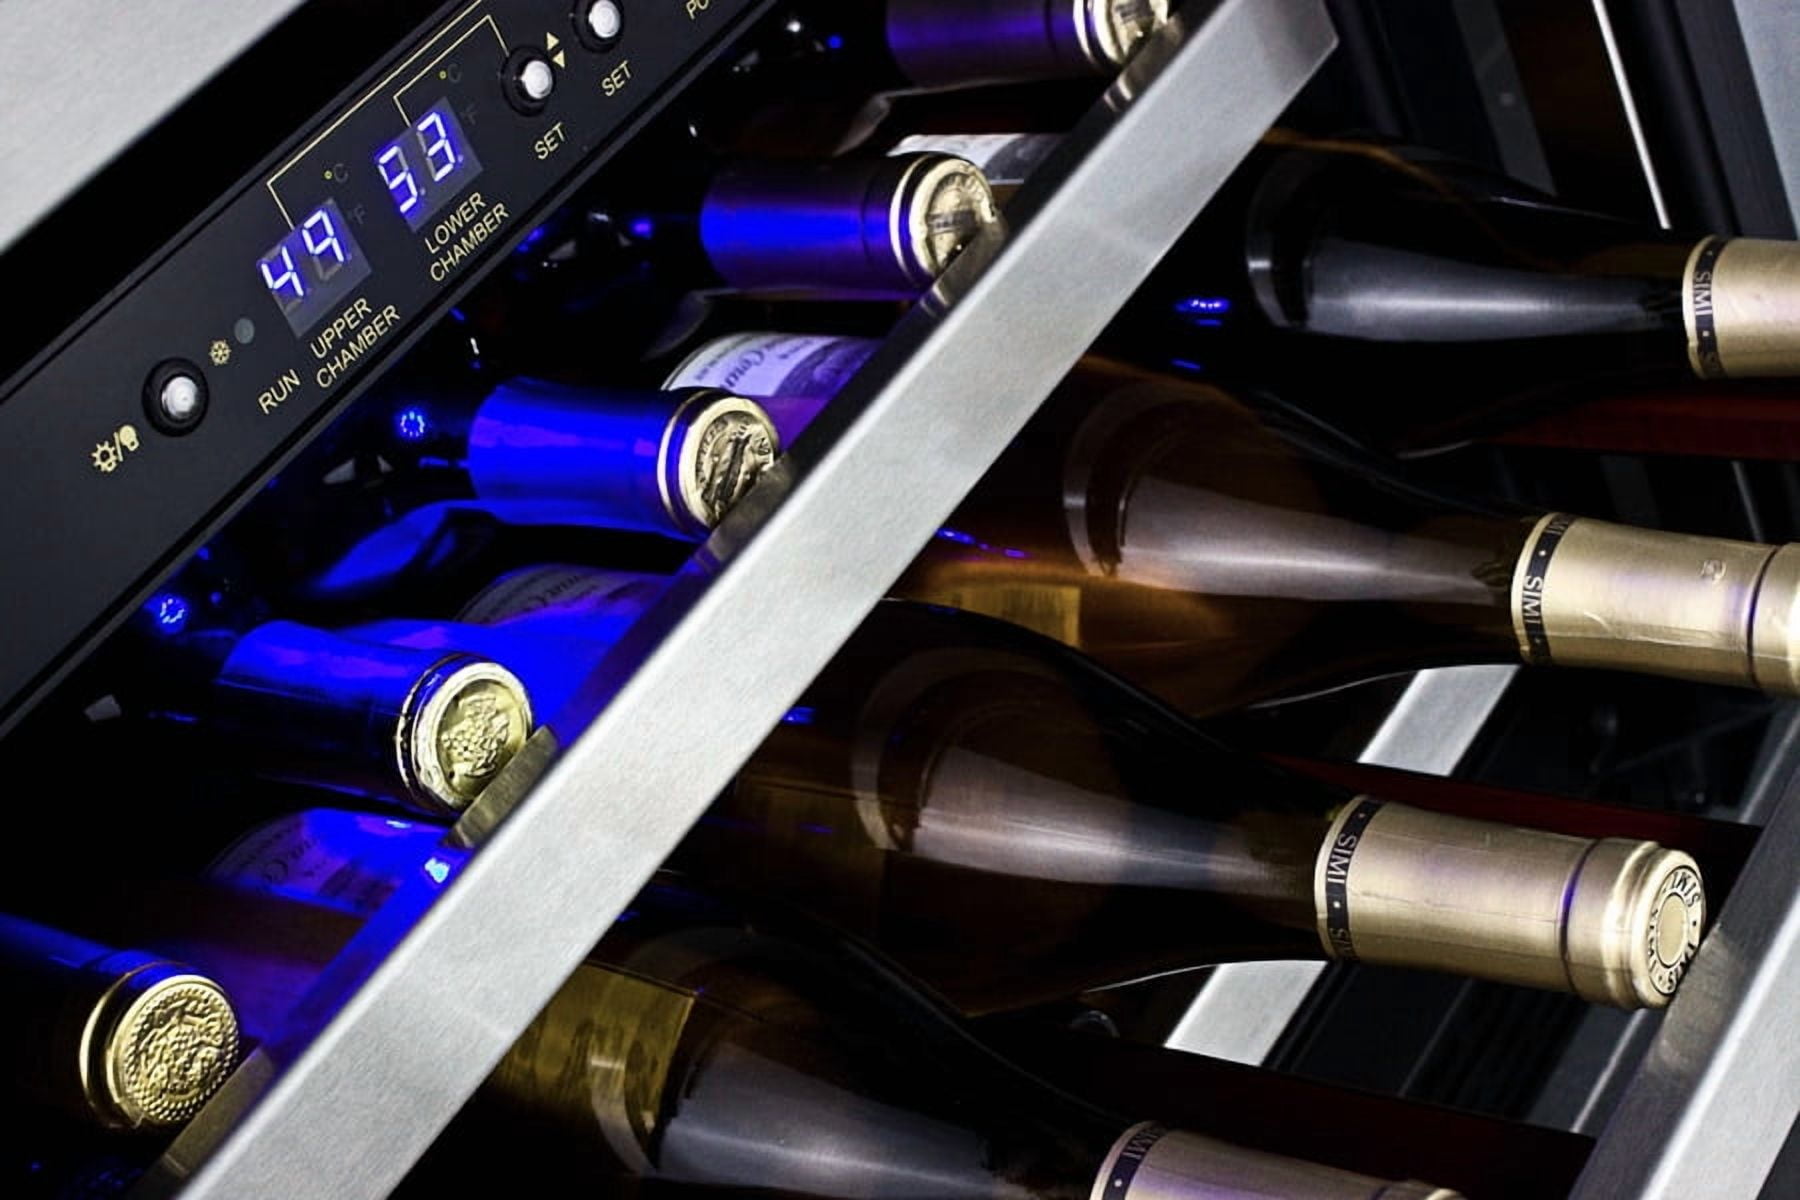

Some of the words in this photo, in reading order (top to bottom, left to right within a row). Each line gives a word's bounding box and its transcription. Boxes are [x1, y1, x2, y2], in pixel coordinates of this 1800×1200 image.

[686, 0, 709, 20] PO
[602, 60, 633, 96] SET
[378, 112, 456, 213] 53
[534, 122, 566, 160] SET
[425, 192, 486, 254] LOWER
[430, 202, 509, 281] CHAMBER
[262, 210, 344, 296] 49
[1693, 271, 1713, 316] SIMI
[310, 298, 373, 358] UPPER
[316, 305, 400, 387] CHAMBER
[258, 369, 300, 414] RUN
[1522, 576, 1543, 624] SIMI
[1327, 833, 1357, 884] SIMI
